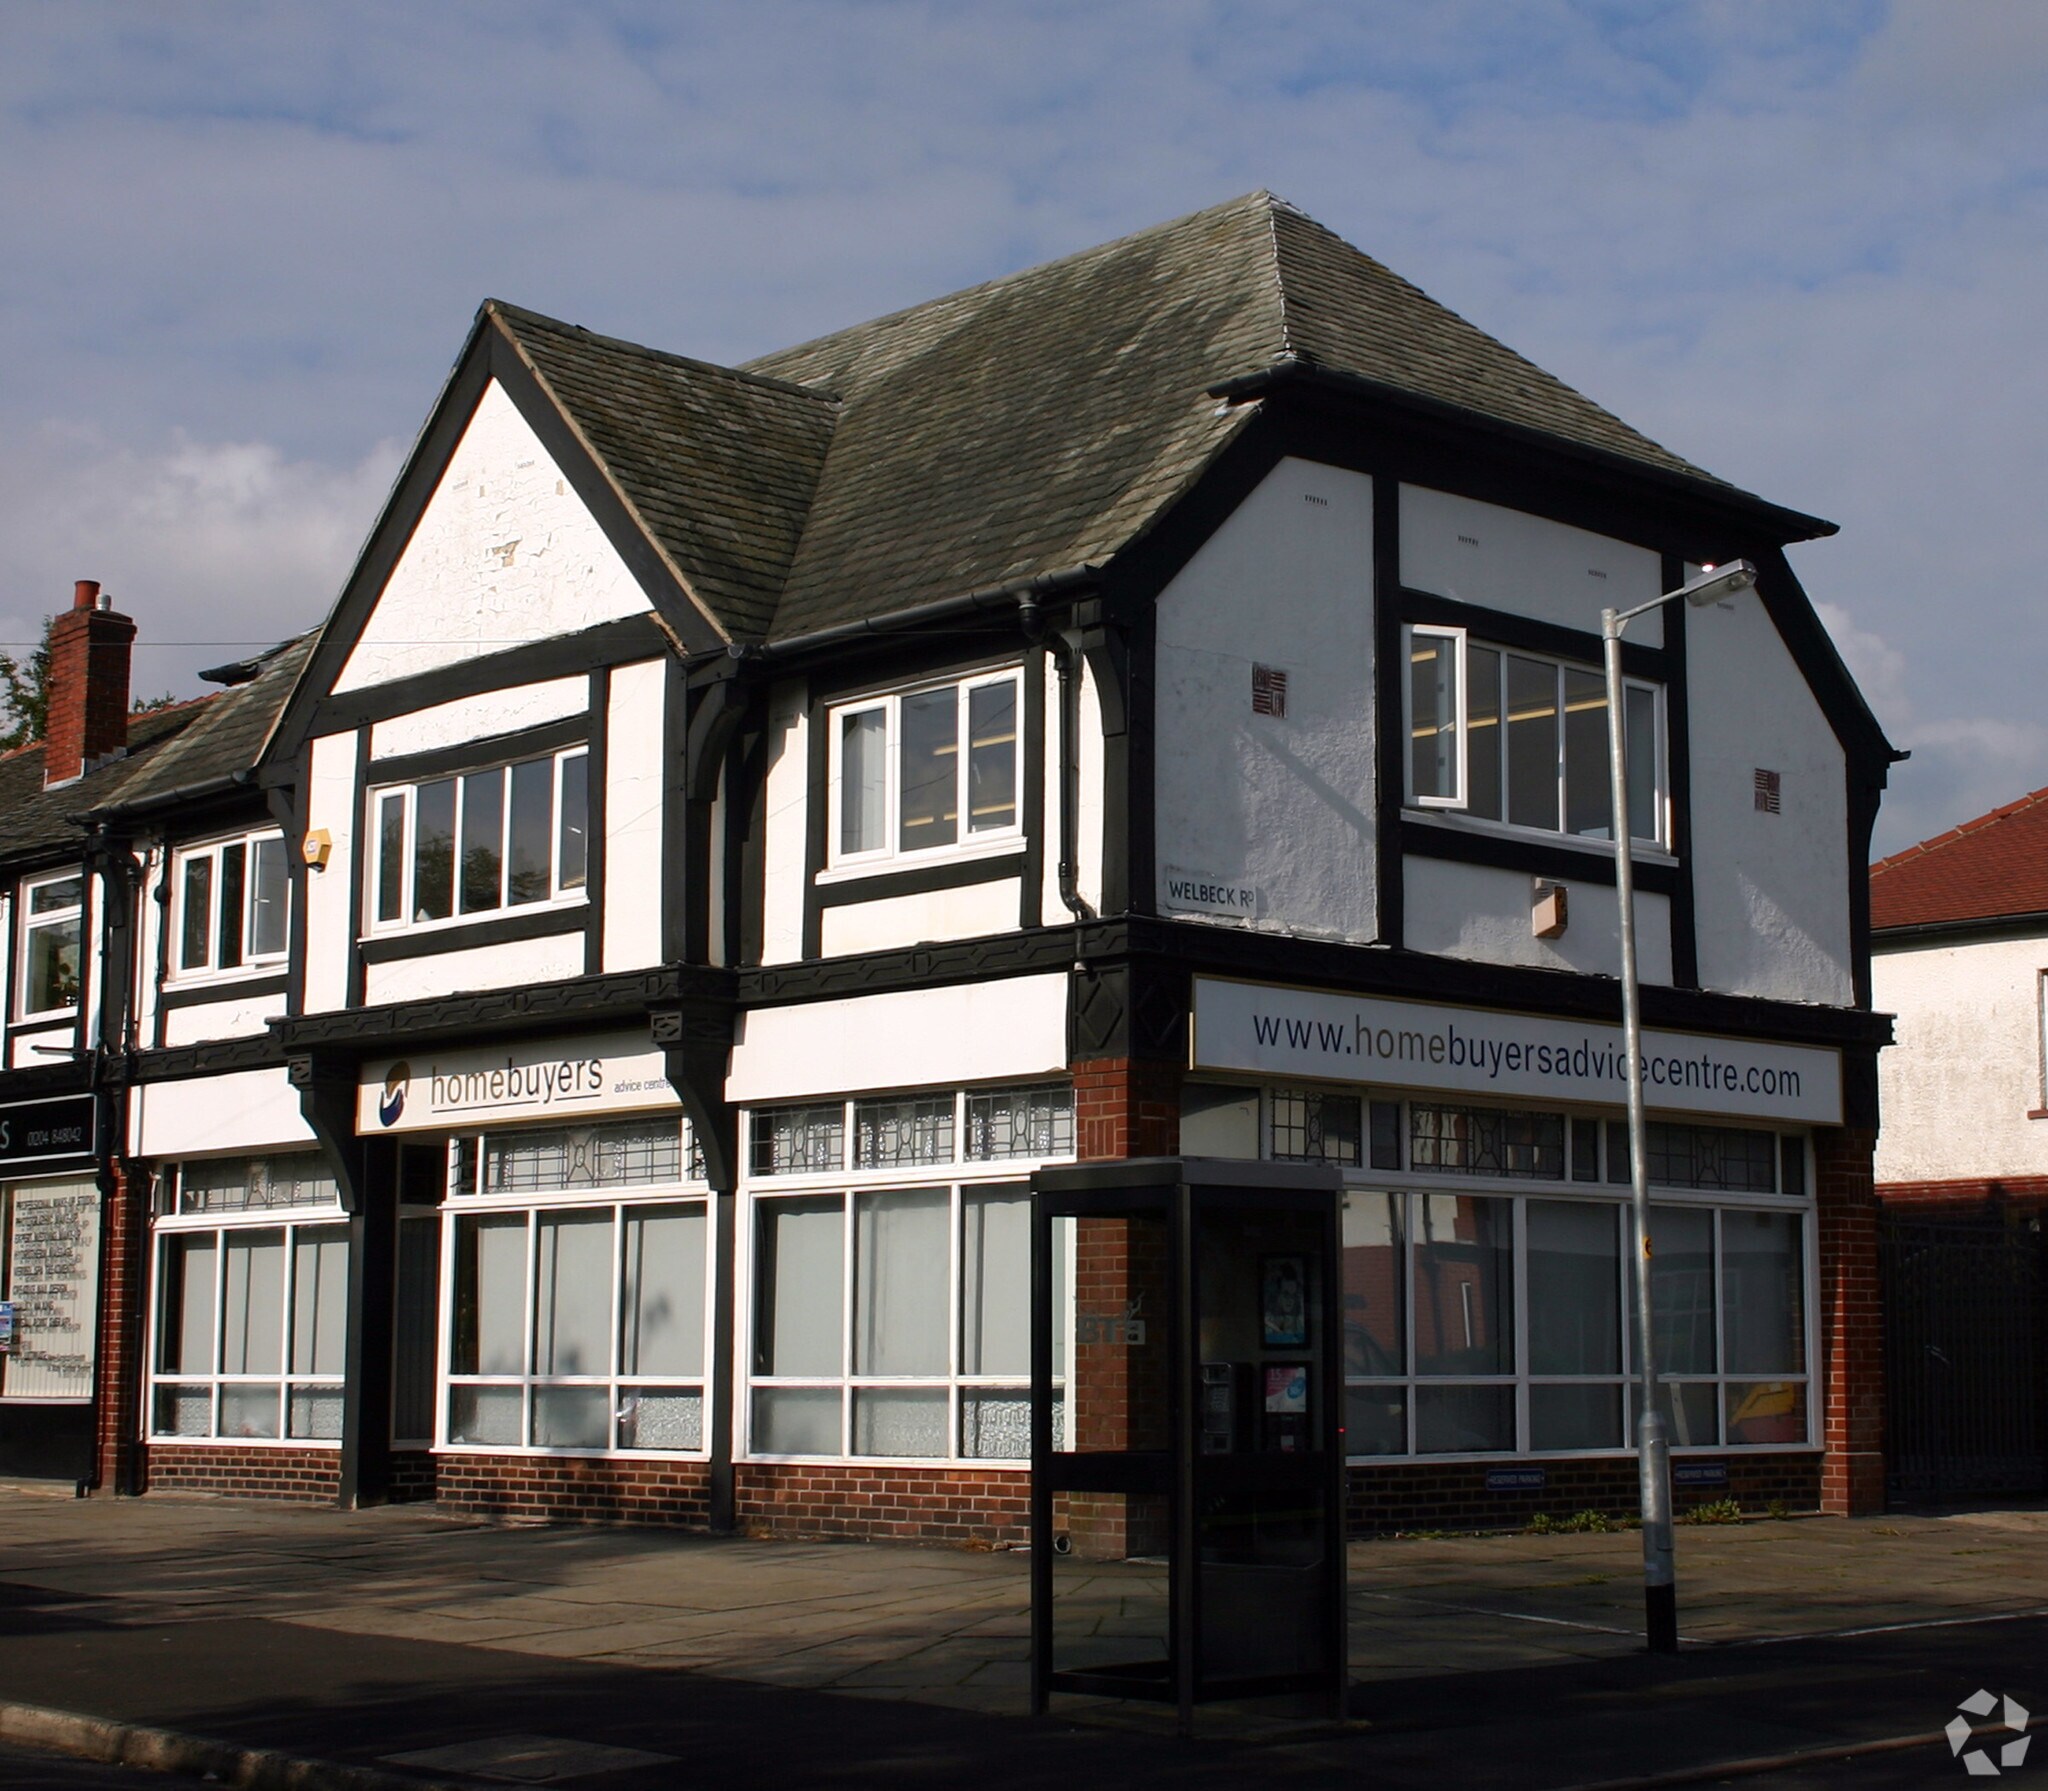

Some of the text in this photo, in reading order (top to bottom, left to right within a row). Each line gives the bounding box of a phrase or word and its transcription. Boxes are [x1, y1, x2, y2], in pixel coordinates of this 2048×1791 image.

[1169, 880, 1236, 906] WELBECK
[1253, 1013, 1802, 1098] www.homebuyersadvicecentre.com
[431, 1057, 673, 1105] homebuyers advice centre
[1078, 1317, 1119, 1344] BT
